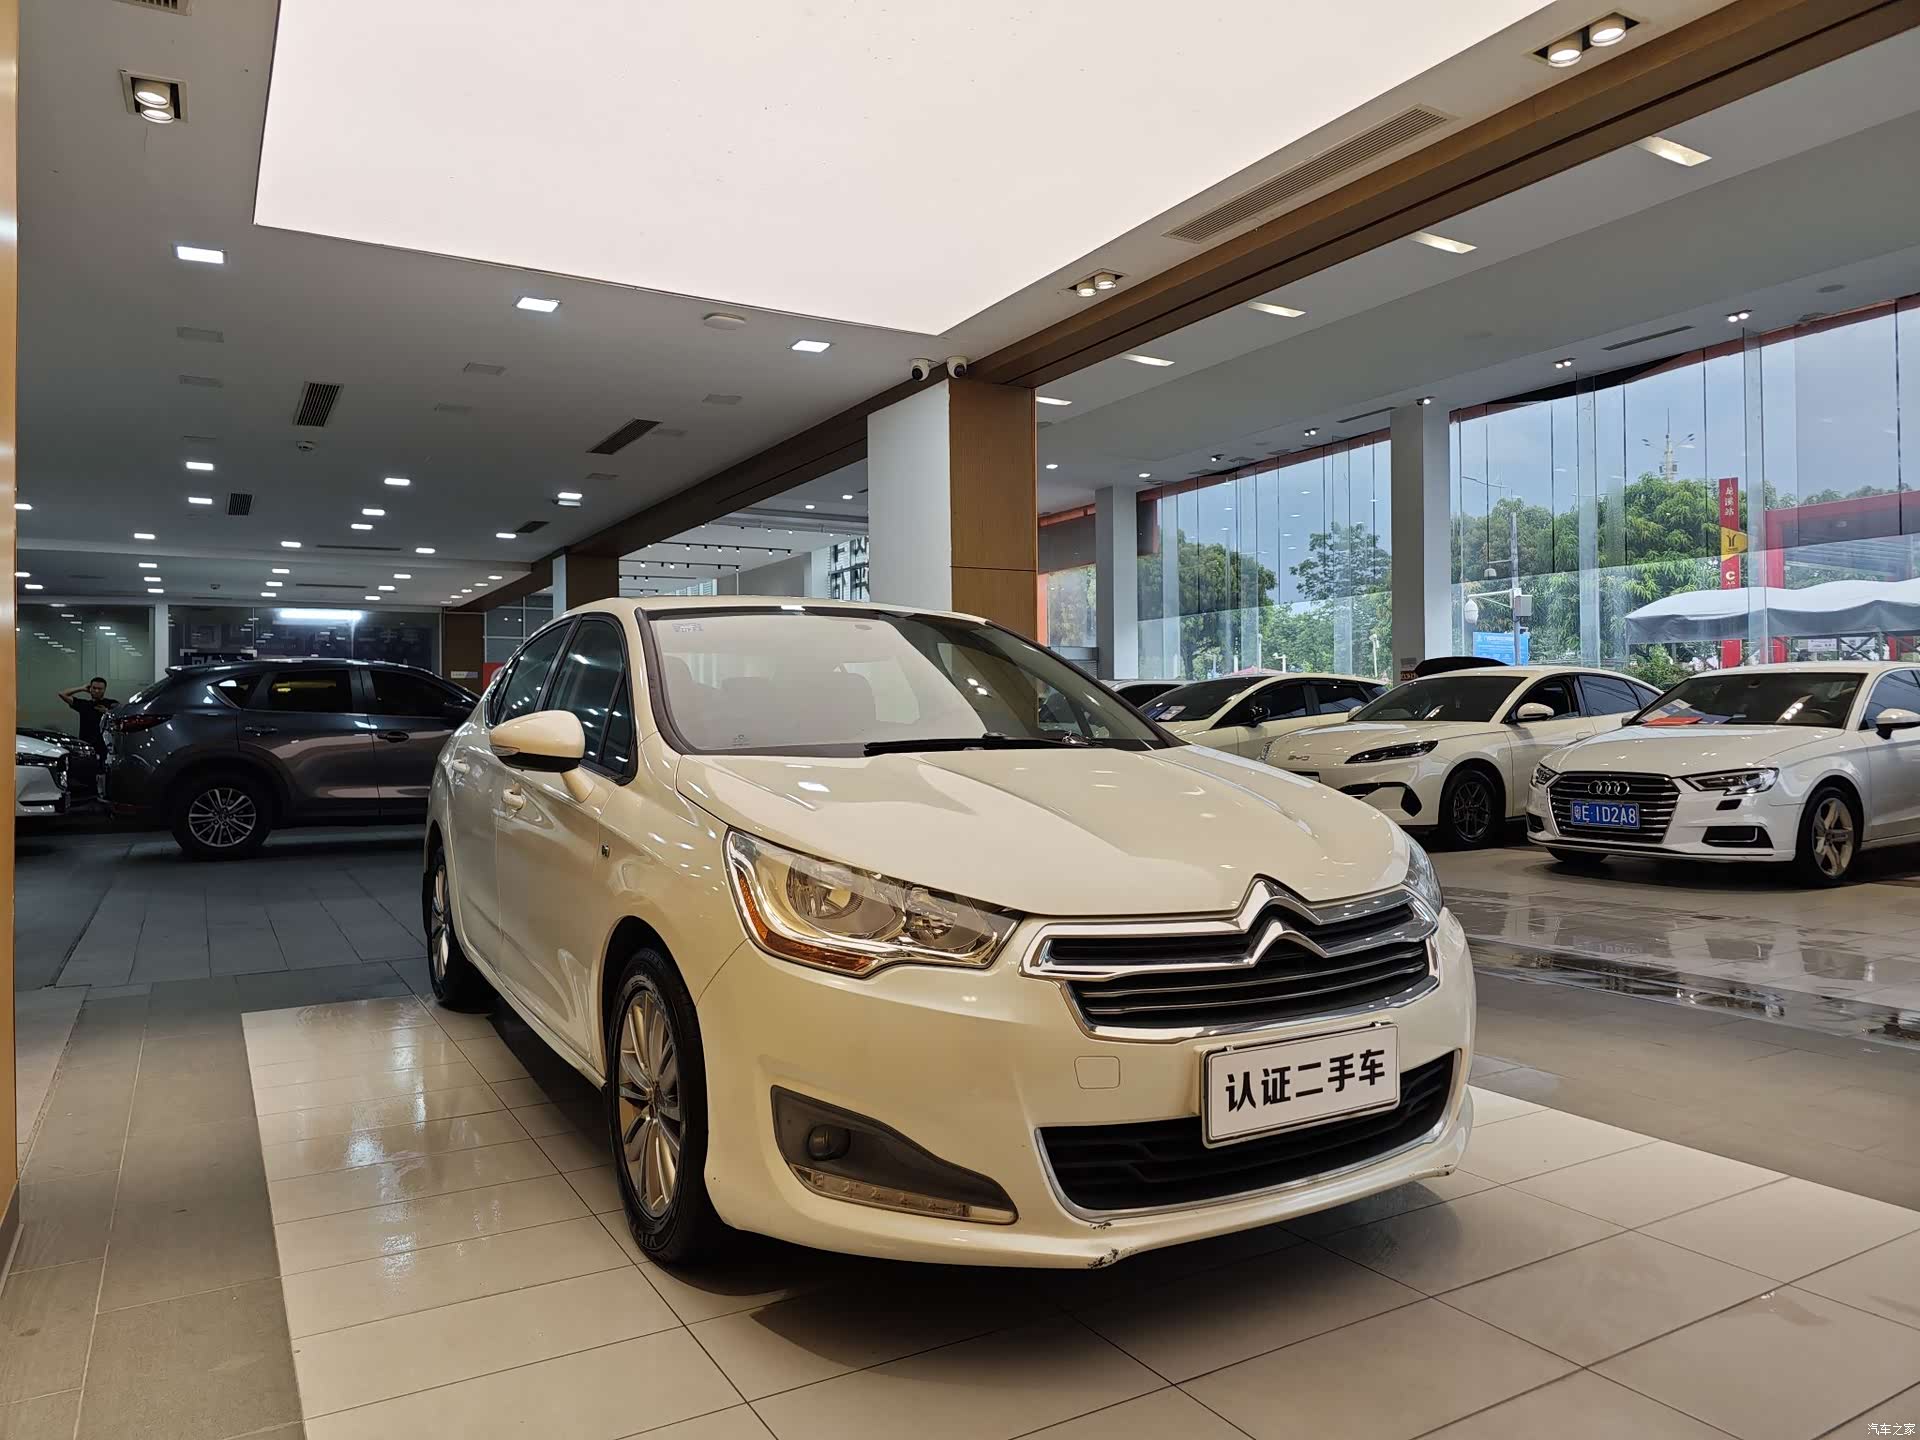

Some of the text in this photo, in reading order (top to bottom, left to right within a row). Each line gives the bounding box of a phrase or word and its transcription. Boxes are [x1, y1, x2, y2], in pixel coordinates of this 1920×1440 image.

[1225, 1048, 1386, 1113] 认证二手车
